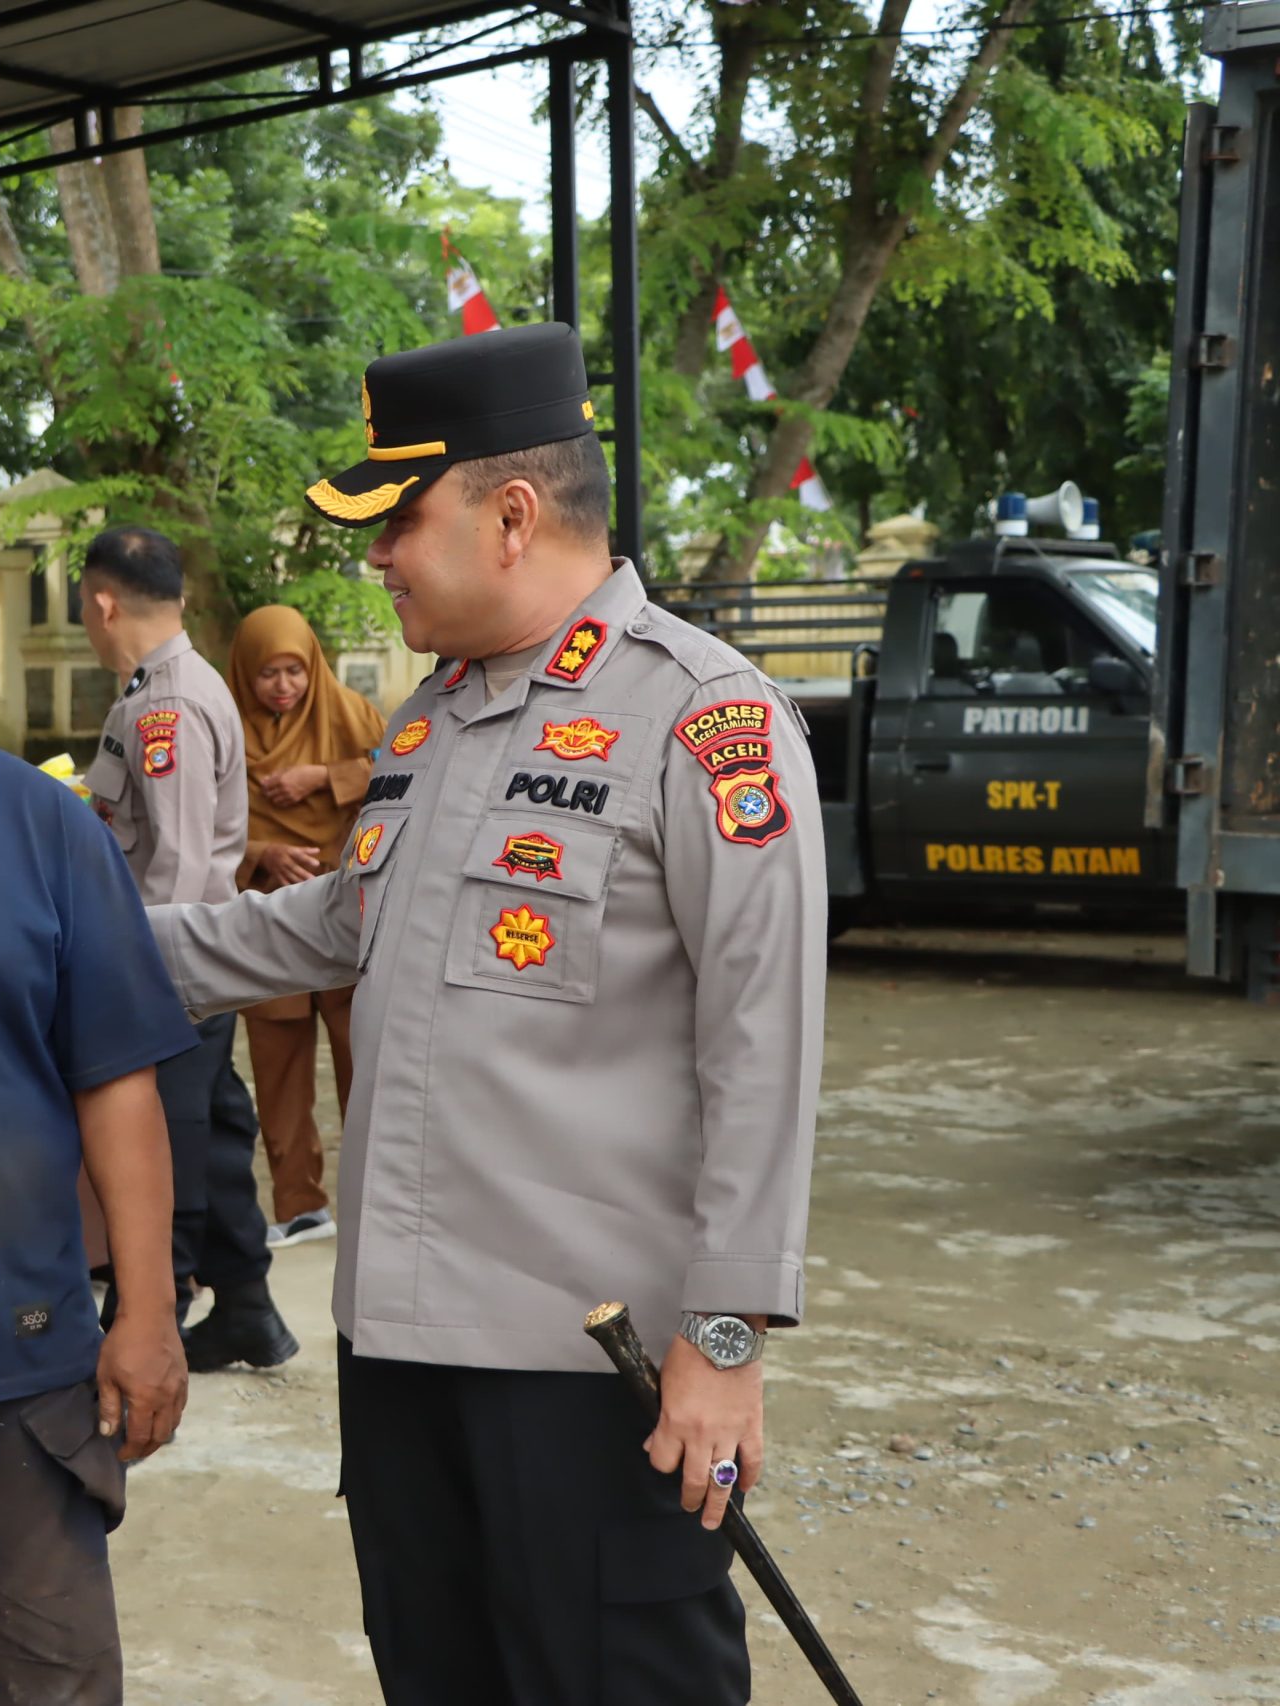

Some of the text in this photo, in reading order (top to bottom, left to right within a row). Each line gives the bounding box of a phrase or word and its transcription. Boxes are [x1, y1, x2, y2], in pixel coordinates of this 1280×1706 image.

[684, 705, 765, 741] POLRES
[693, 719, 762, 747] ACEH TAMIANG
[963, 706, 1090, 735] PATROLI
[711, 742, 762, 766] ACEH
[505, 772, 610, 815] POLRI
[986, 780, 1061, 810] SPK-T
[925, 843, 1141, 875] POLRES ATAM
